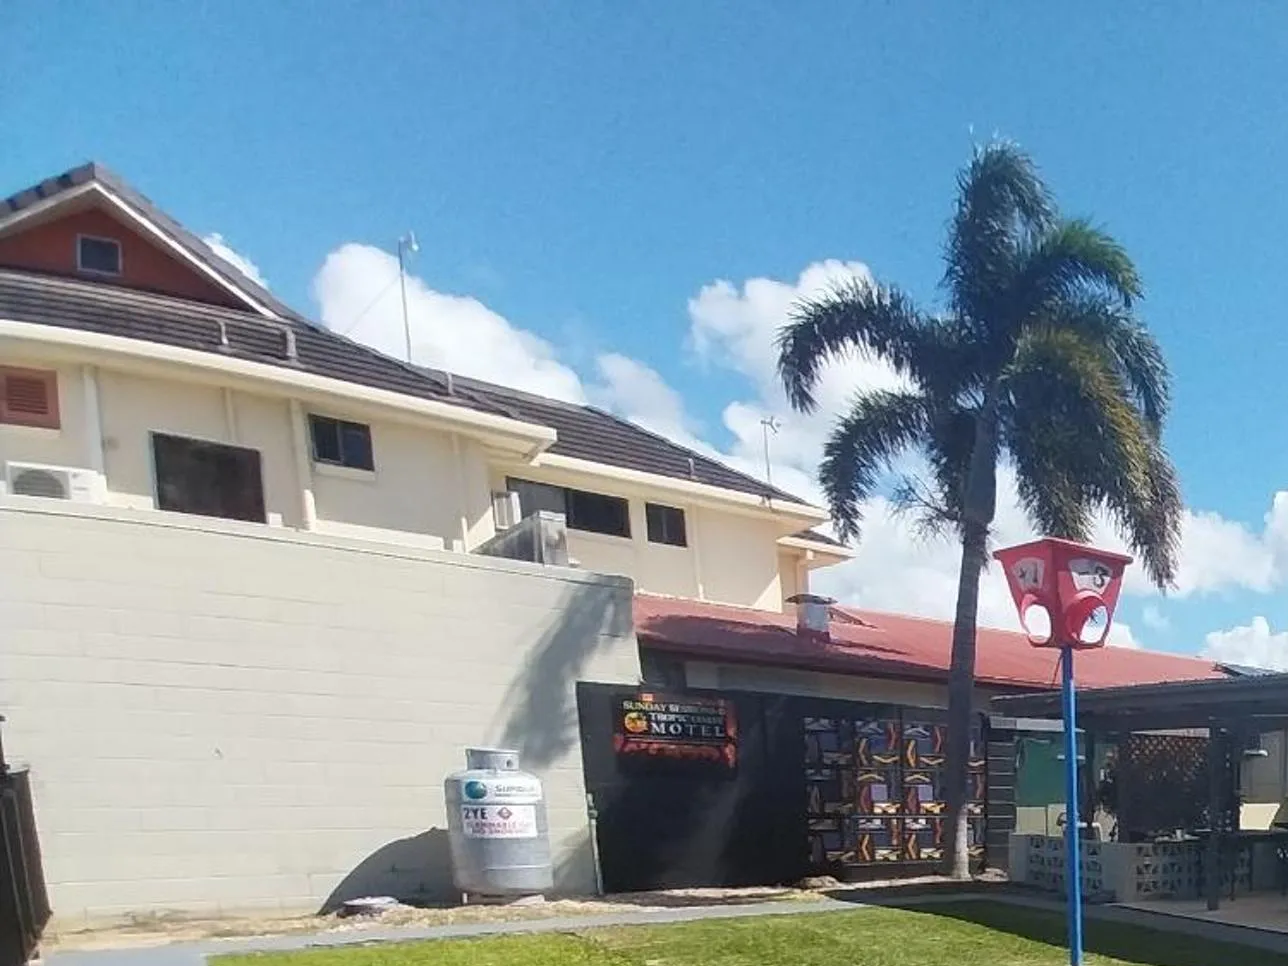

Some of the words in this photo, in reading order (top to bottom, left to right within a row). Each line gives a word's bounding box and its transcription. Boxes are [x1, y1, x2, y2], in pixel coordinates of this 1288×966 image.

[623, 700, 667, 712] SUNDAY
[651, 722, 725, 737] MOTEL
[463, 807, 488, 820] 2YE
